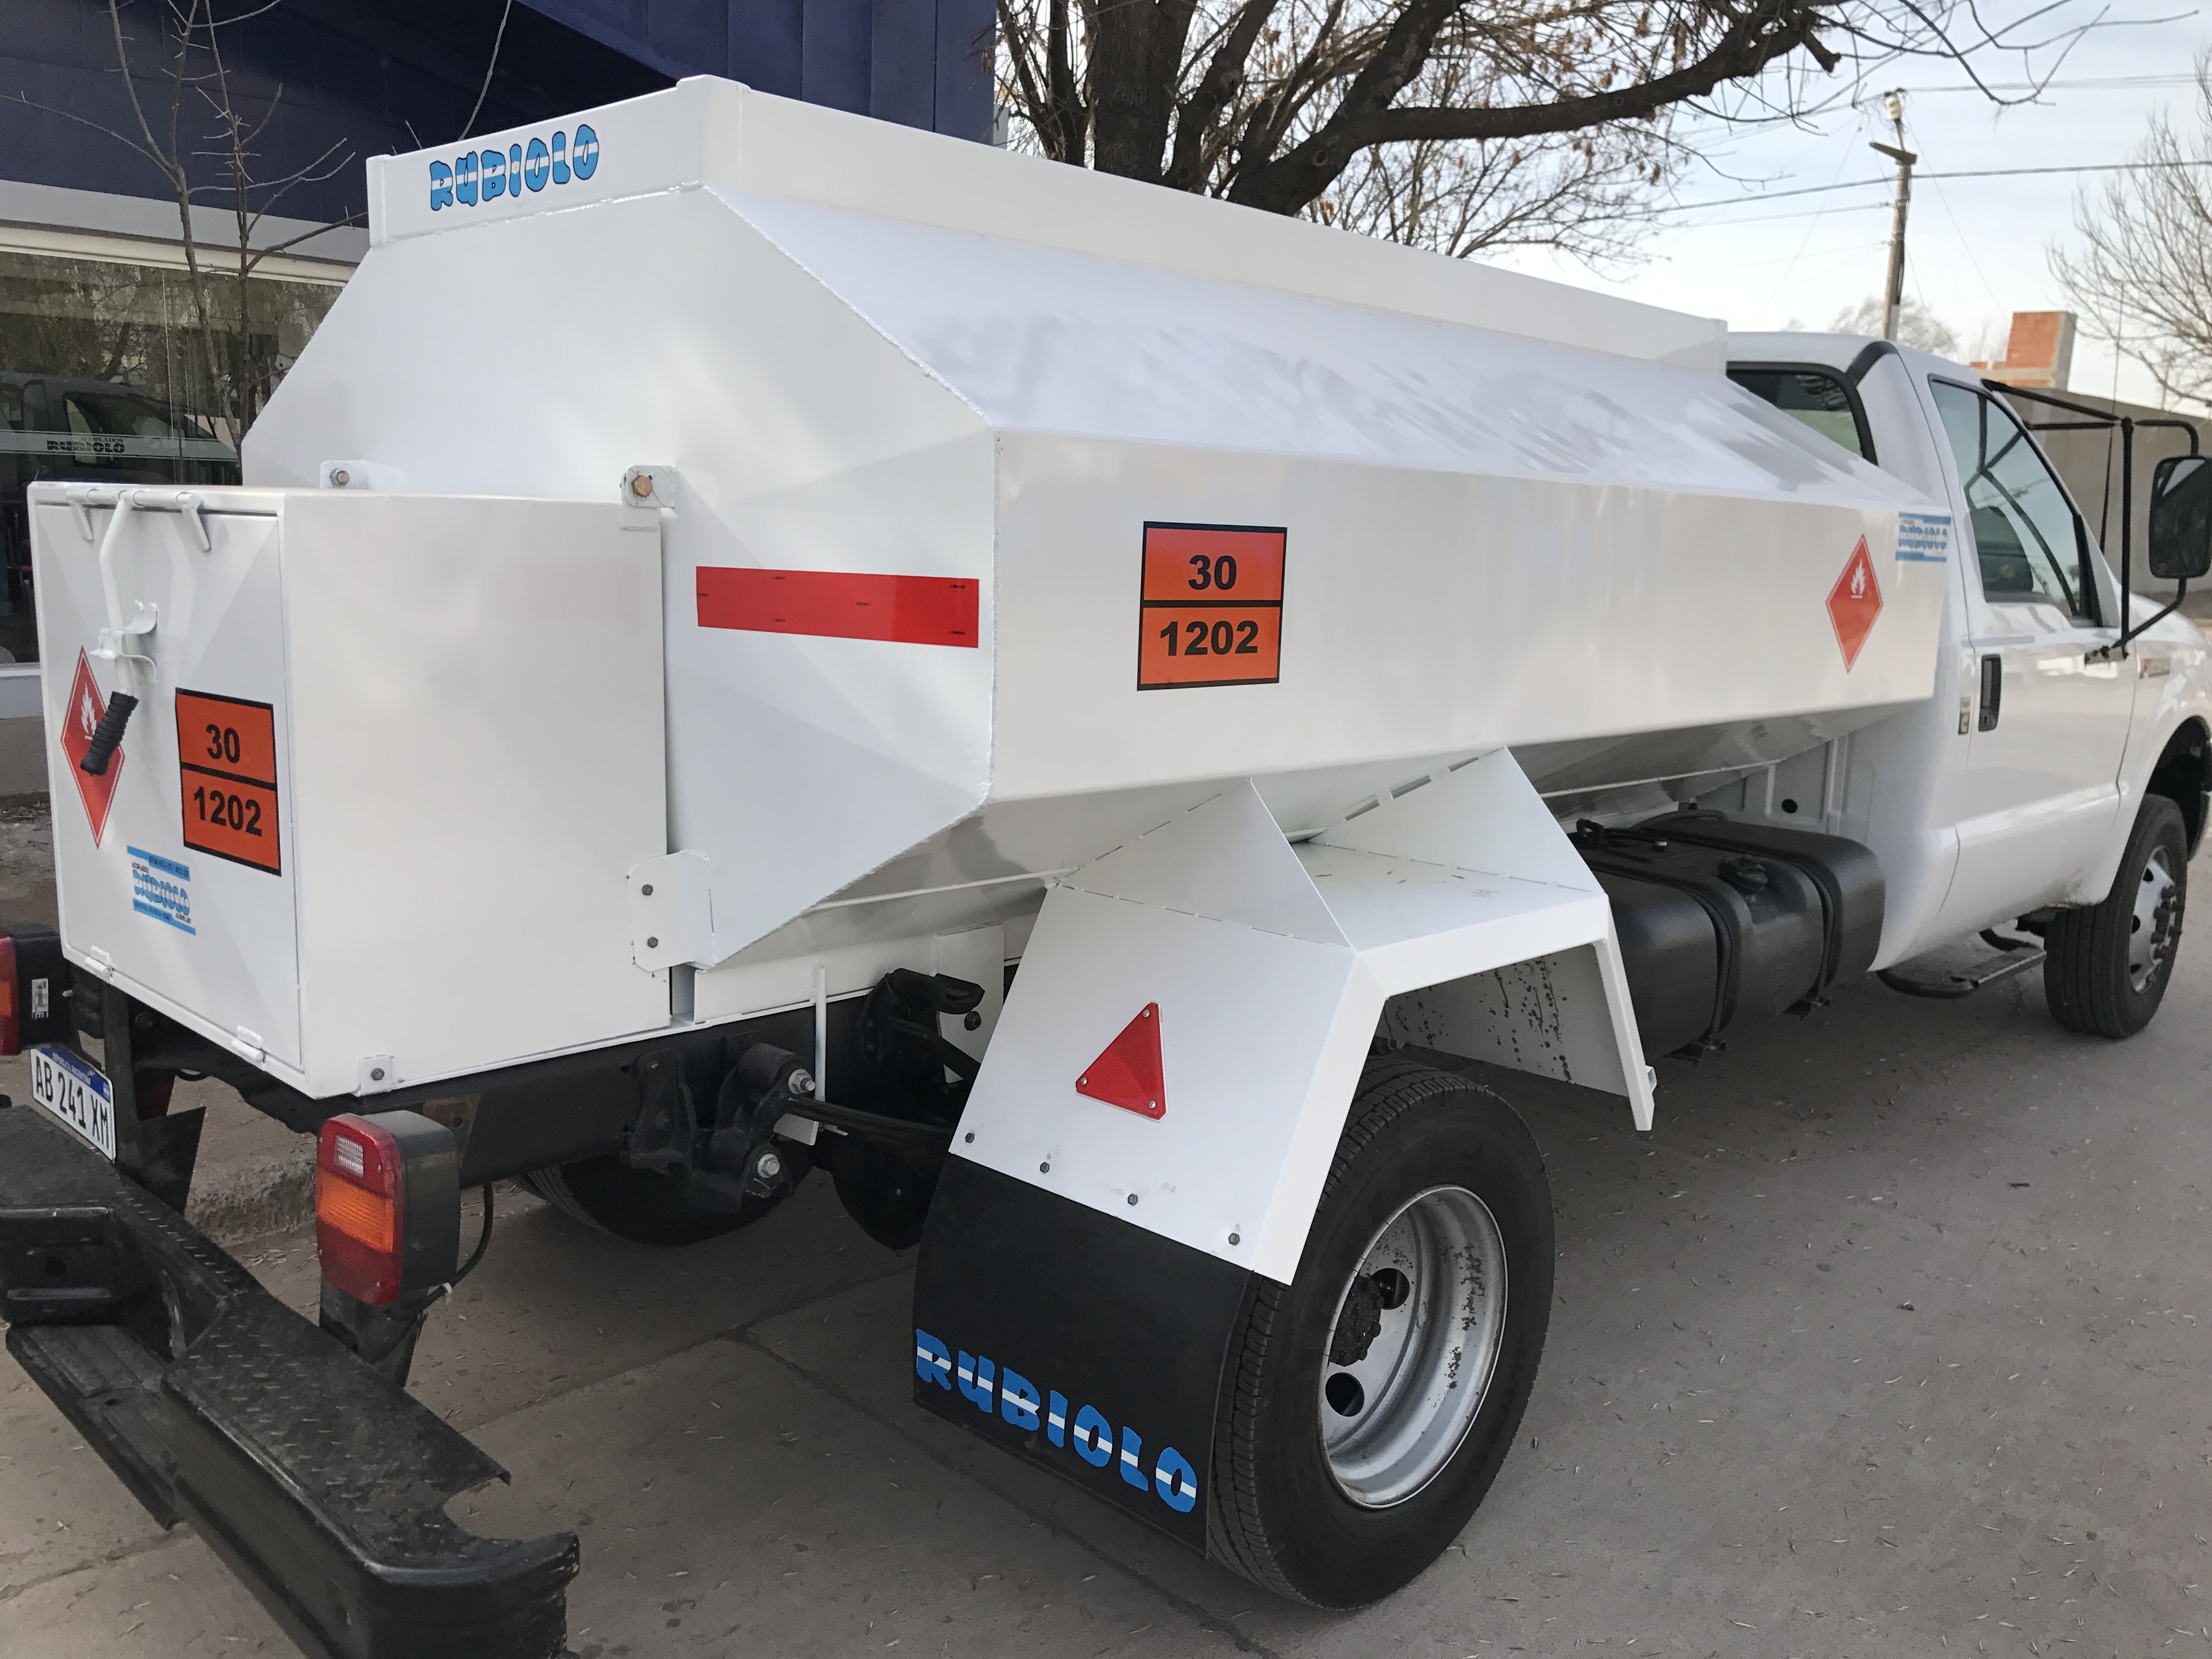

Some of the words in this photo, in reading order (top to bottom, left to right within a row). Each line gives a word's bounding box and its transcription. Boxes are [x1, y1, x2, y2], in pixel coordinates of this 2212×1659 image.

[430, 124, 599, 211] RUBIOLO
[47, 440, 125, 453] RUBIOLO
[1188, 555, 1237, 590] 30
[1160, 620, 1259, 656] 1202
[206, 724, 241, 764] 30
[194, 786, 262, 837] 1202
[36, 1056, 54, 1103] AB
[58, 1071, 87, 1130] 241
[91, 1094, 109, 1150] XM
[916, 1328, 1198, 1513] RUBIOLO
